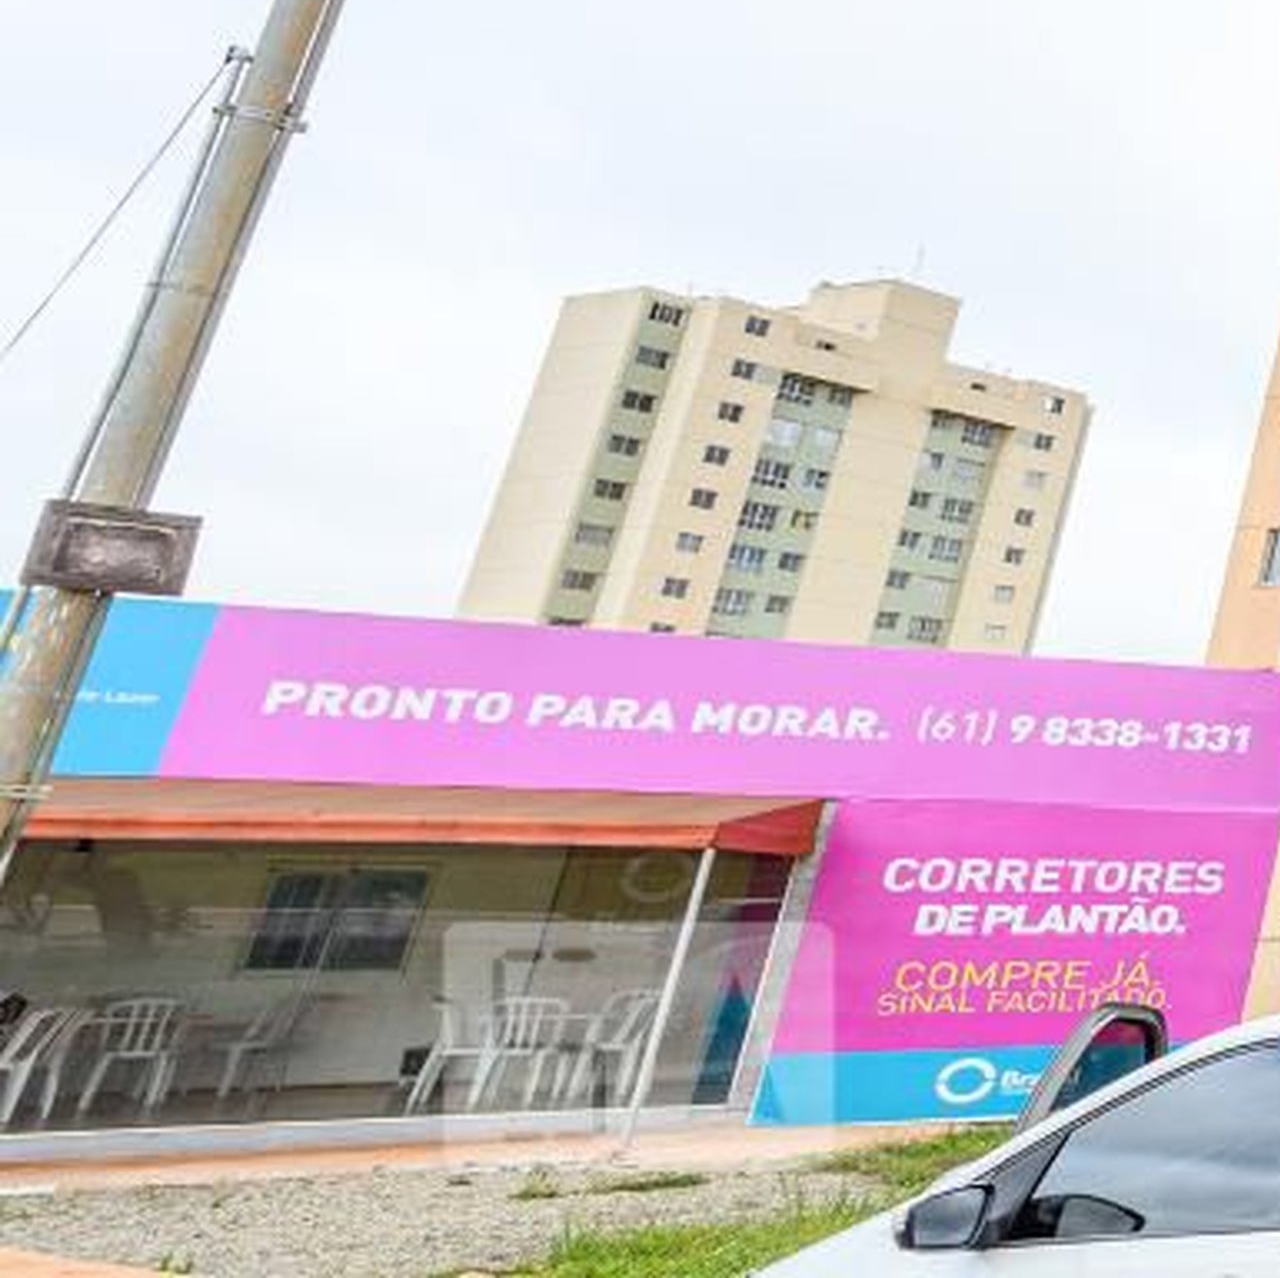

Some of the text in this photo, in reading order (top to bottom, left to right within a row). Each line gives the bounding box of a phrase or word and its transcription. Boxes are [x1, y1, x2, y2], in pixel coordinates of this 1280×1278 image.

[263, 681, 1252, 753] PRONTO PARA MORAR. (61) 9 8338-1331
[883, 857, 1225, 894] CORRETORES
[913, 896, 1187, 936] DE PLANTÃO.
[896, 960, 1091, 992] COMPRE
[878, 989, 976, 1016] SINAL
